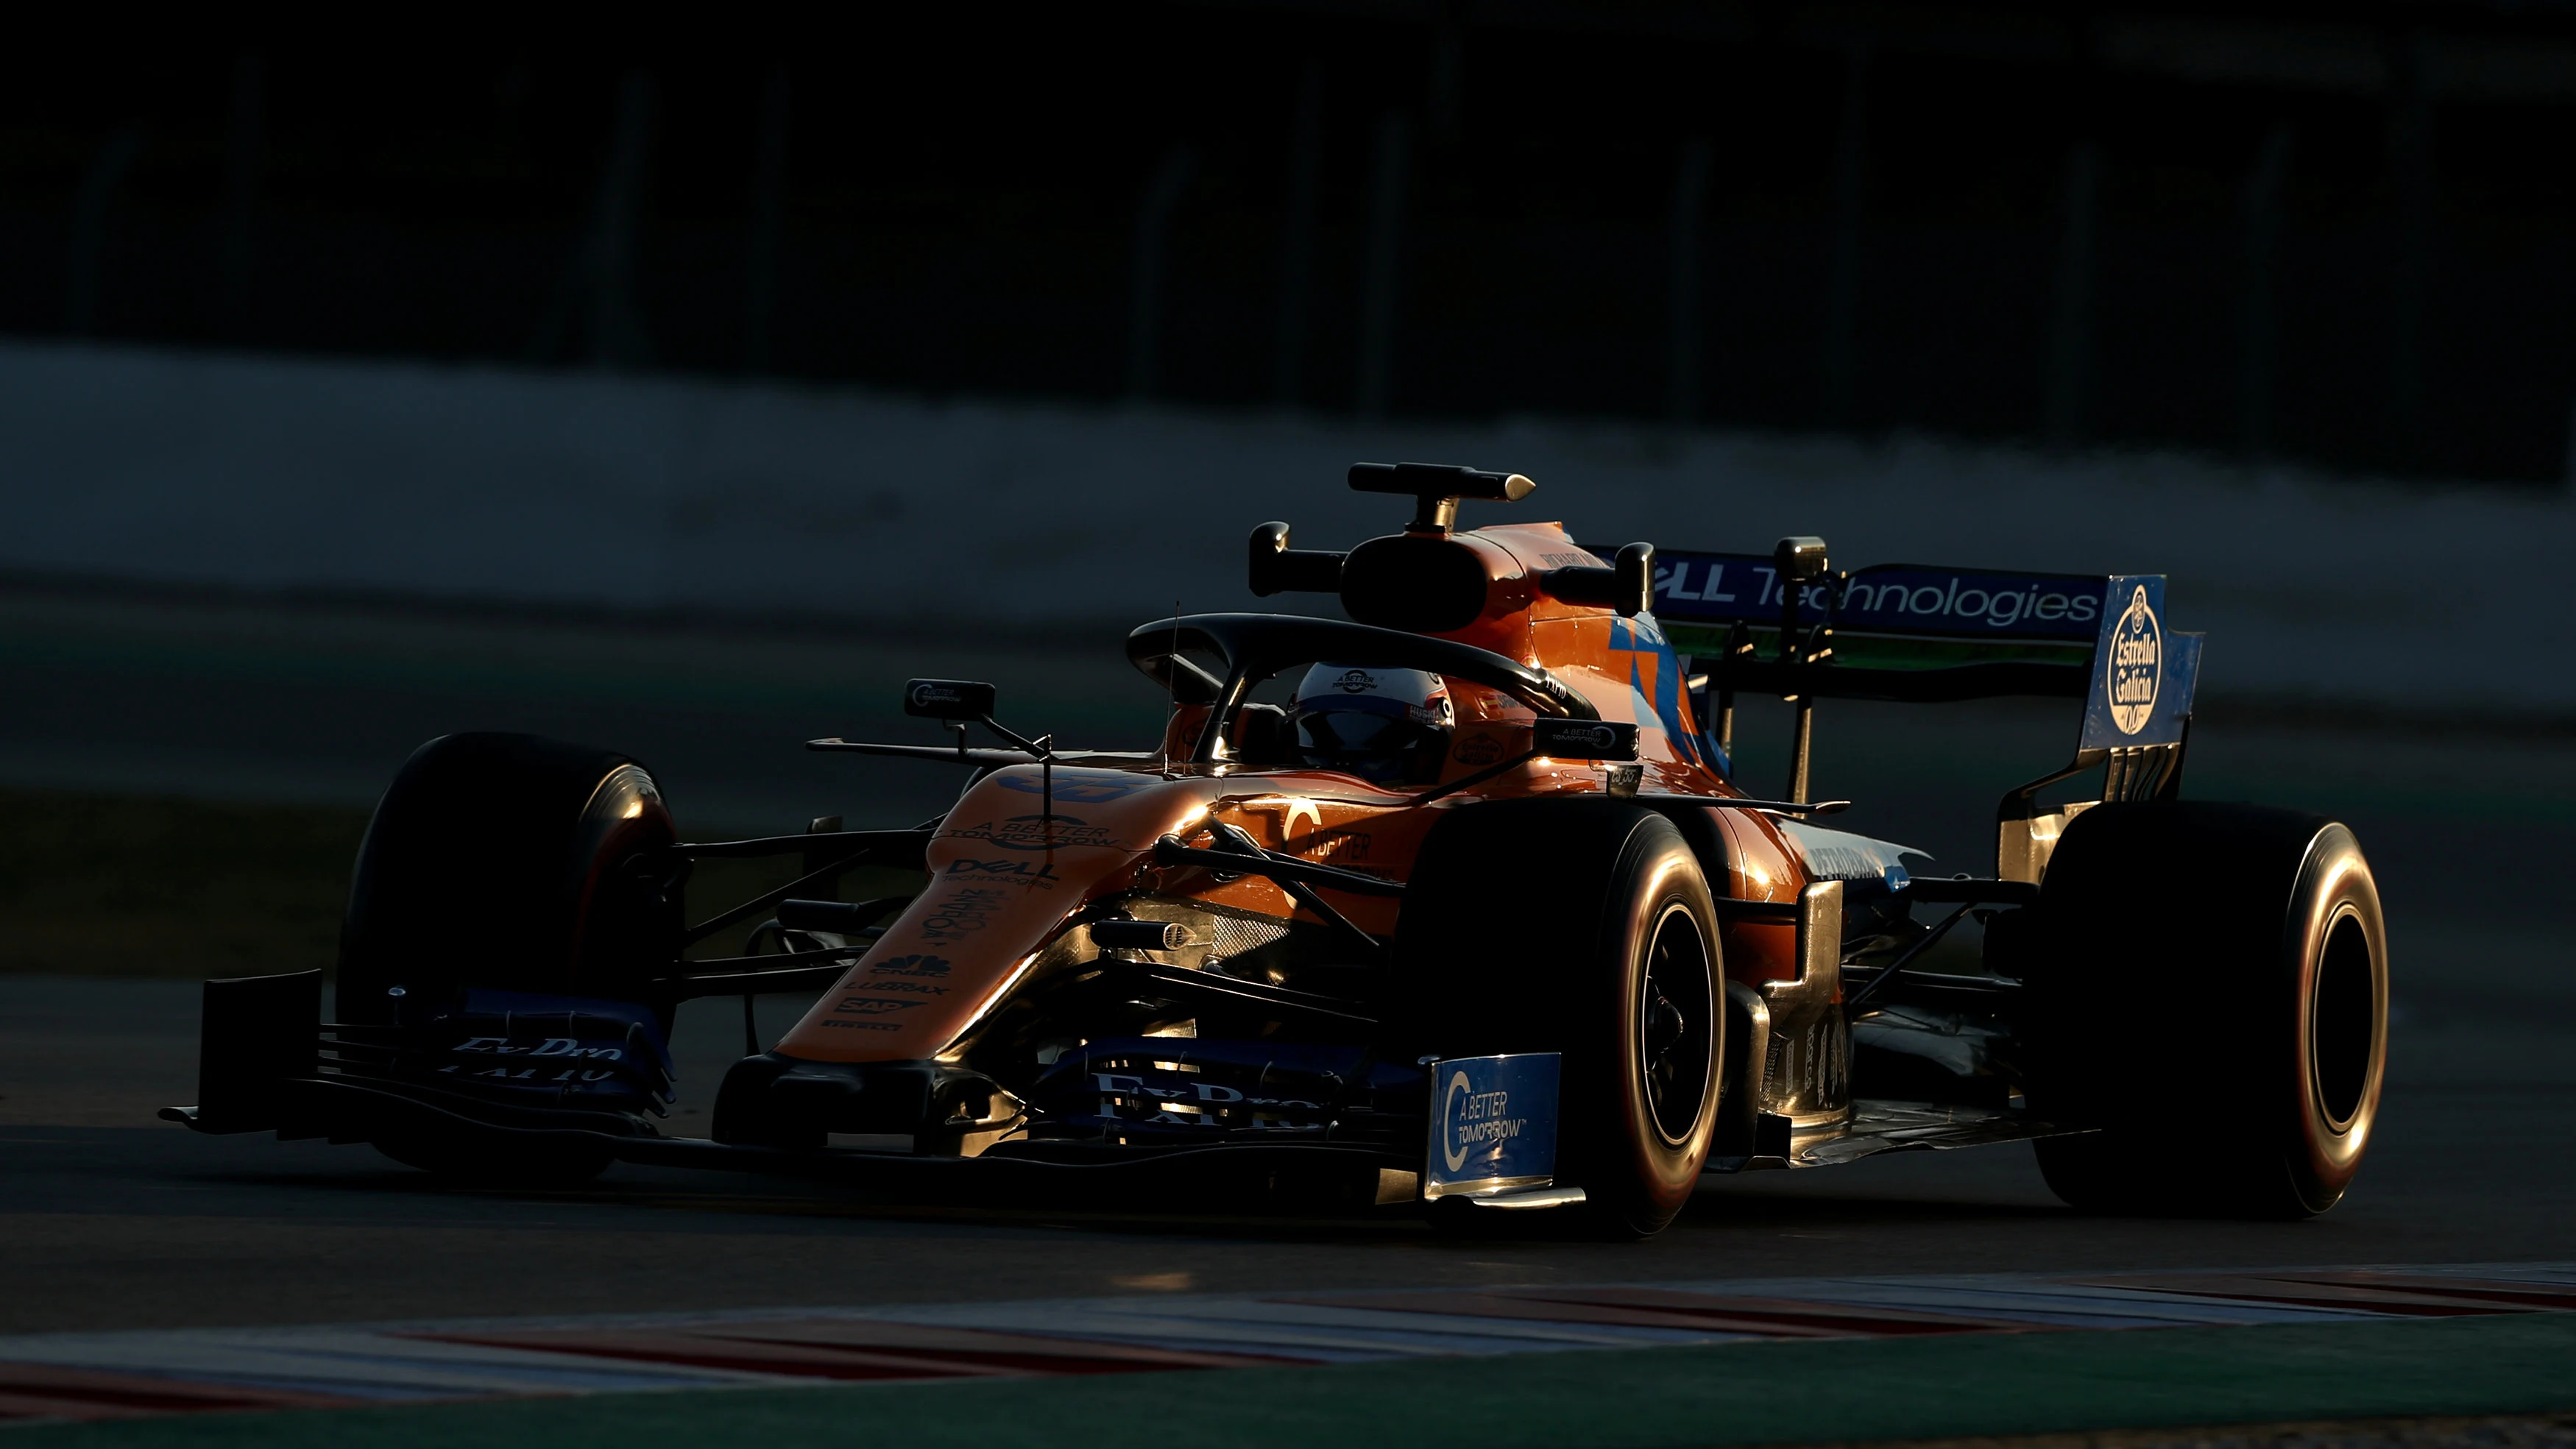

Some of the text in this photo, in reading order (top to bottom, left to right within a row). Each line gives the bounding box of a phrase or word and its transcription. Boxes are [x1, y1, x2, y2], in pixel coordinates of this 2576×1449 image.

[1752, 566, 2098, 627] Technologies
[2115, 631, 2157, 667] Estrella
[1345, 674, 1374, 683] BETTER
[2115, 666, 2152, 704] Galicia
[1551, 734, 1602, 744] TOMORROW
[1571, 728, 1602, 737] BETTER
[949, 829, 1121, 846] TOMORROW
[1000, 822, 1111, 838] BETTER
[1304, 827, 1373, 861] A BETTER
[946, 859, 1060, 882] DELL
[868, 968, 949, 978] CNBC
[843, 981, 952, 996] LUBRAX
[838, 999, 904, 1013] SAP
[1459, 1091, 1508, 1122] A BETTER
